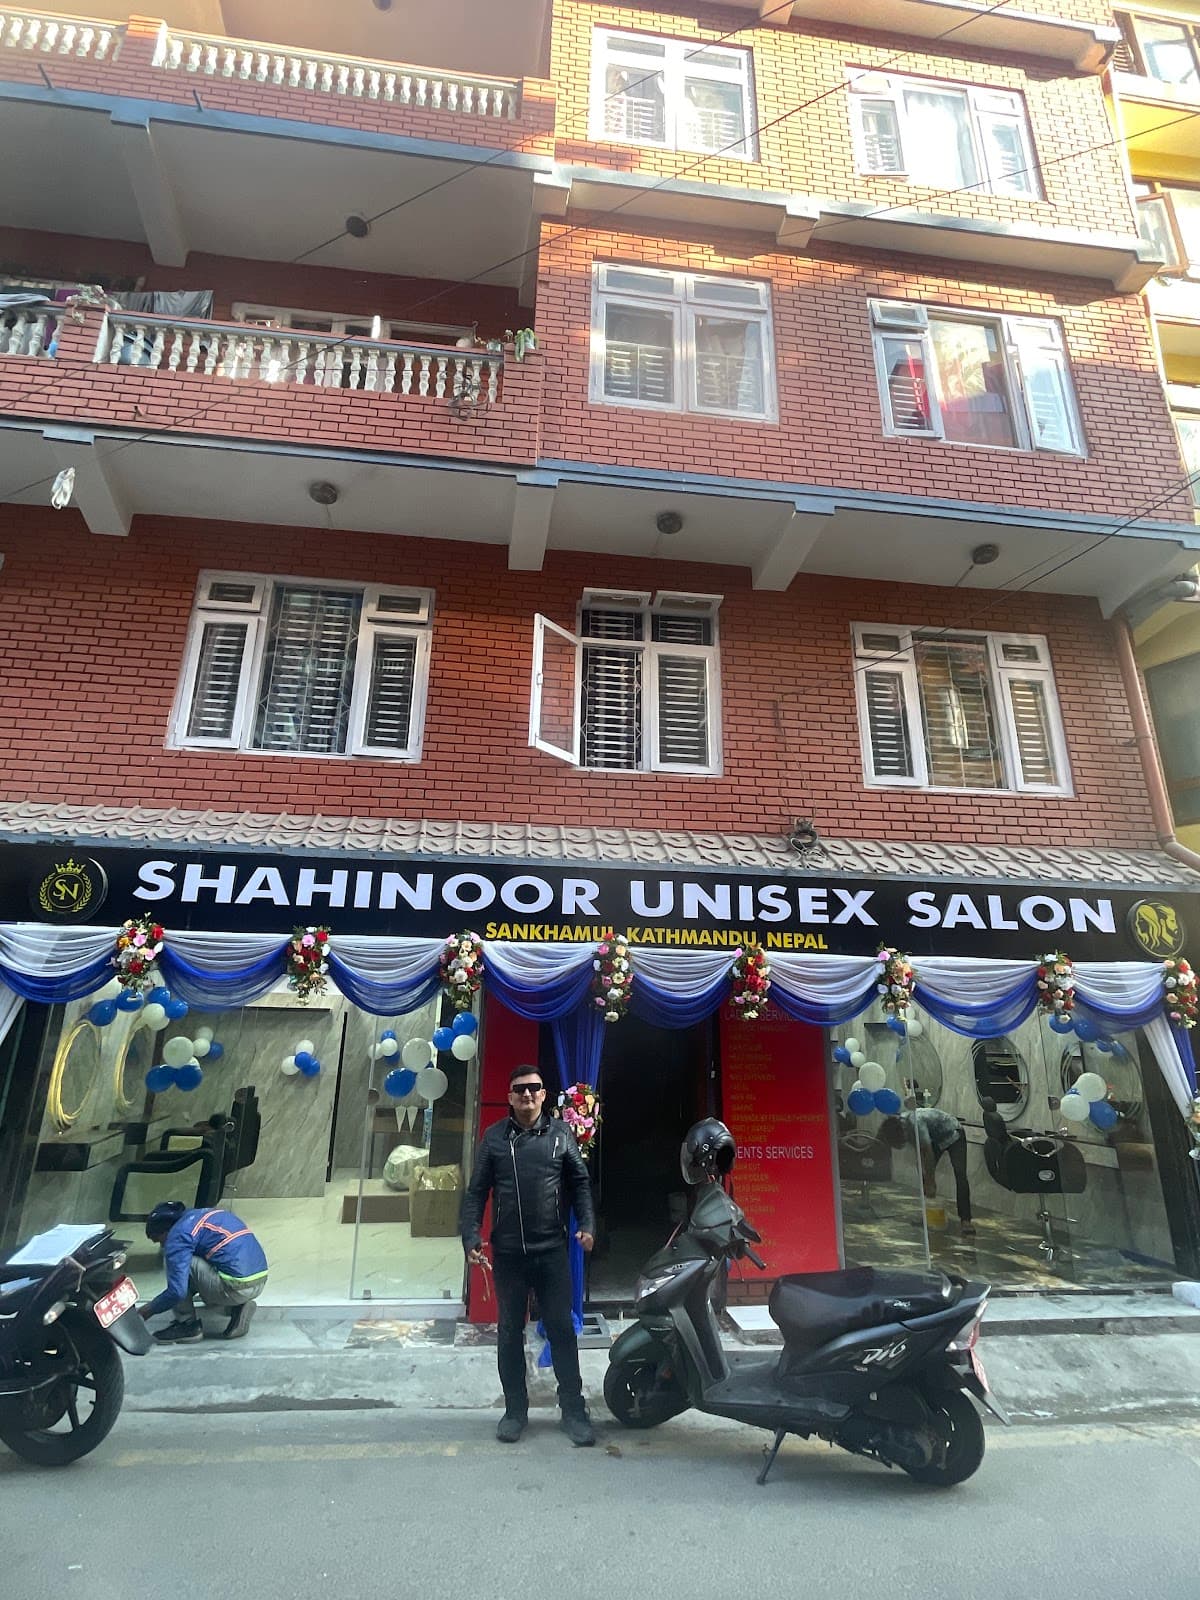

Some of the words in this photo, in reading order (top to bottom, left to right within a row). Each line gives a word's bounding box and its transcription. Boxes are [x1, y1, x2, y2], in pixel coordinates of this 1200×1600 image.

[53, 879, 79, 900] SN
[133, 860, 600, 915] SHAHINOOR
[630, 880, 878, 926] UNISEX
[908, 891, 1117, 934] SALON
[767, 932, 828, 949] NEPAL
[765, 1146, 814, 1159] SERVICES
